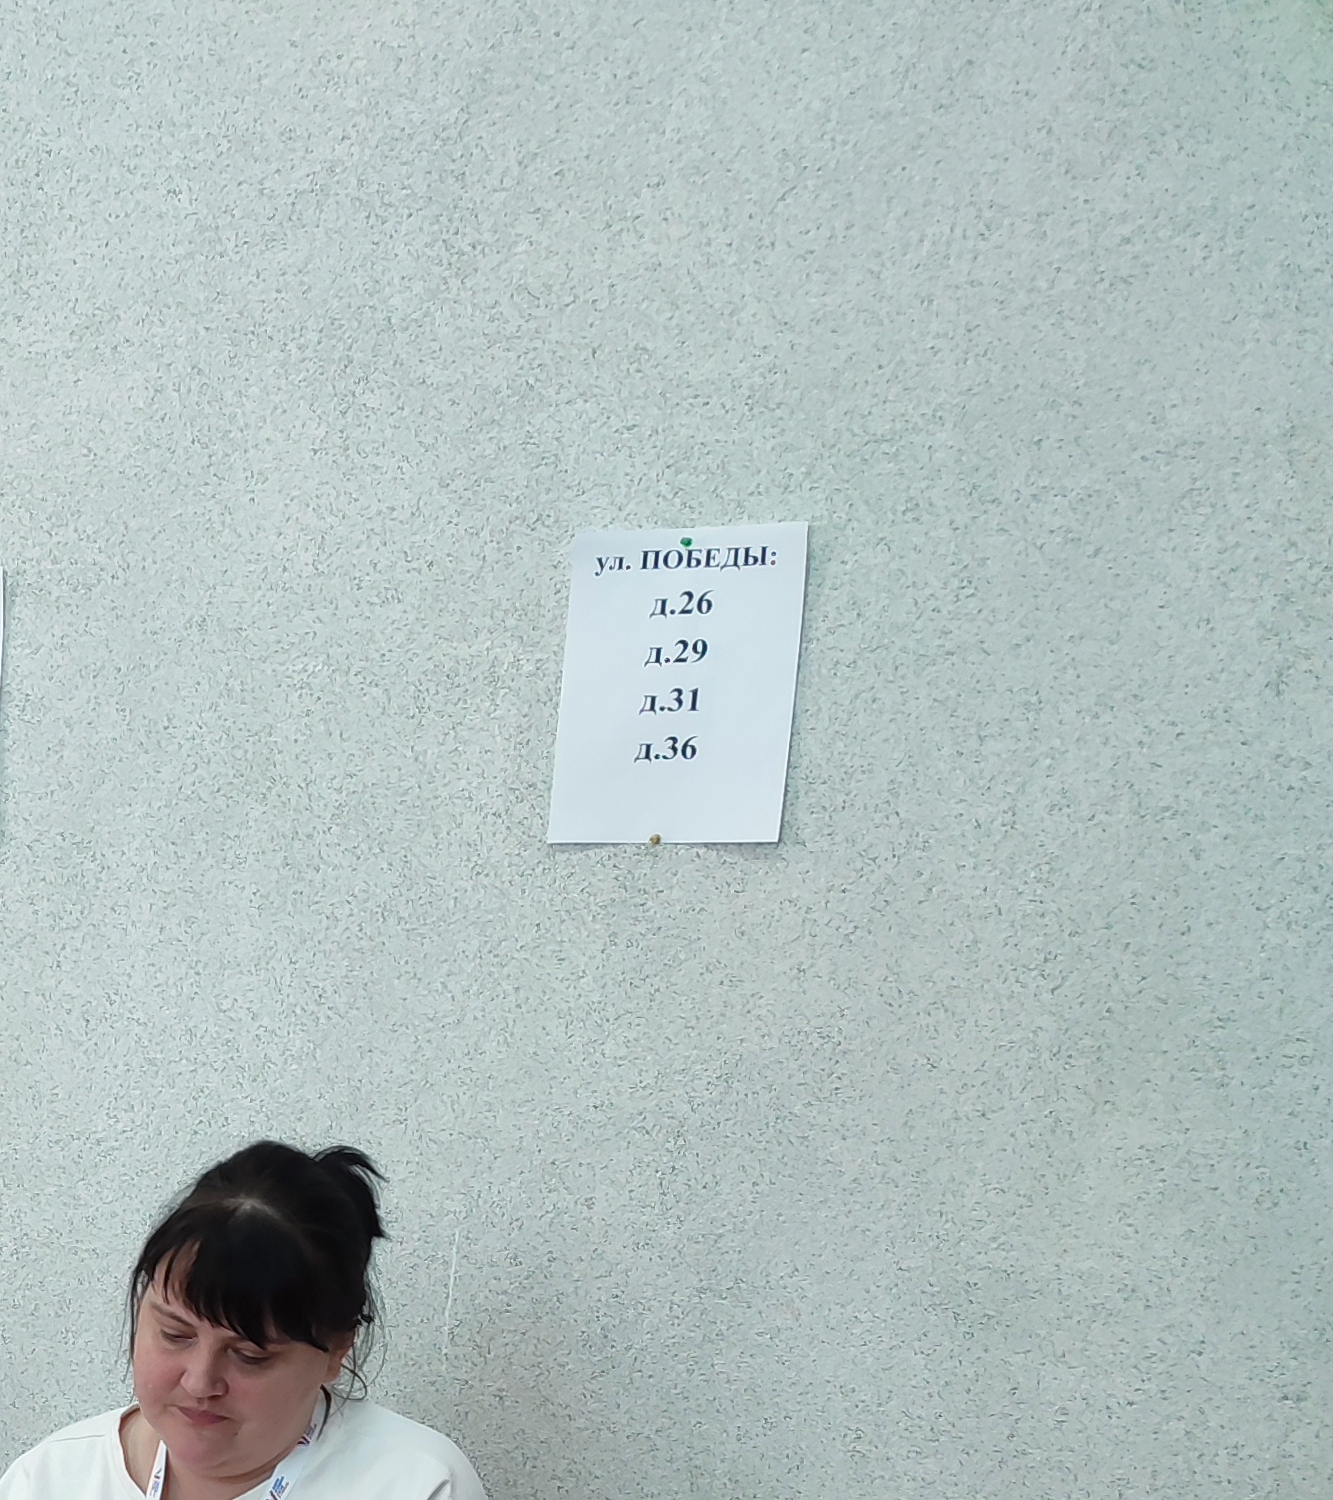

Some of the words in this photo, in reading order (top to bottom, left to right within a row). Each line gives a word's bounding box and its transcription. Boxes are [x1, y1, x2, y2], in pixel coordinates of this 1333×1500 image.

[595, 557, 631, 576] ул.
[641, 545, 776, 570] ПОБЕДЫ:
[650, 590, 713, 618] д.26
[644, 639, 707, 667] д.29
[639, 688, 698, 714] д.31
[634, 736, 696, 763] д.36
